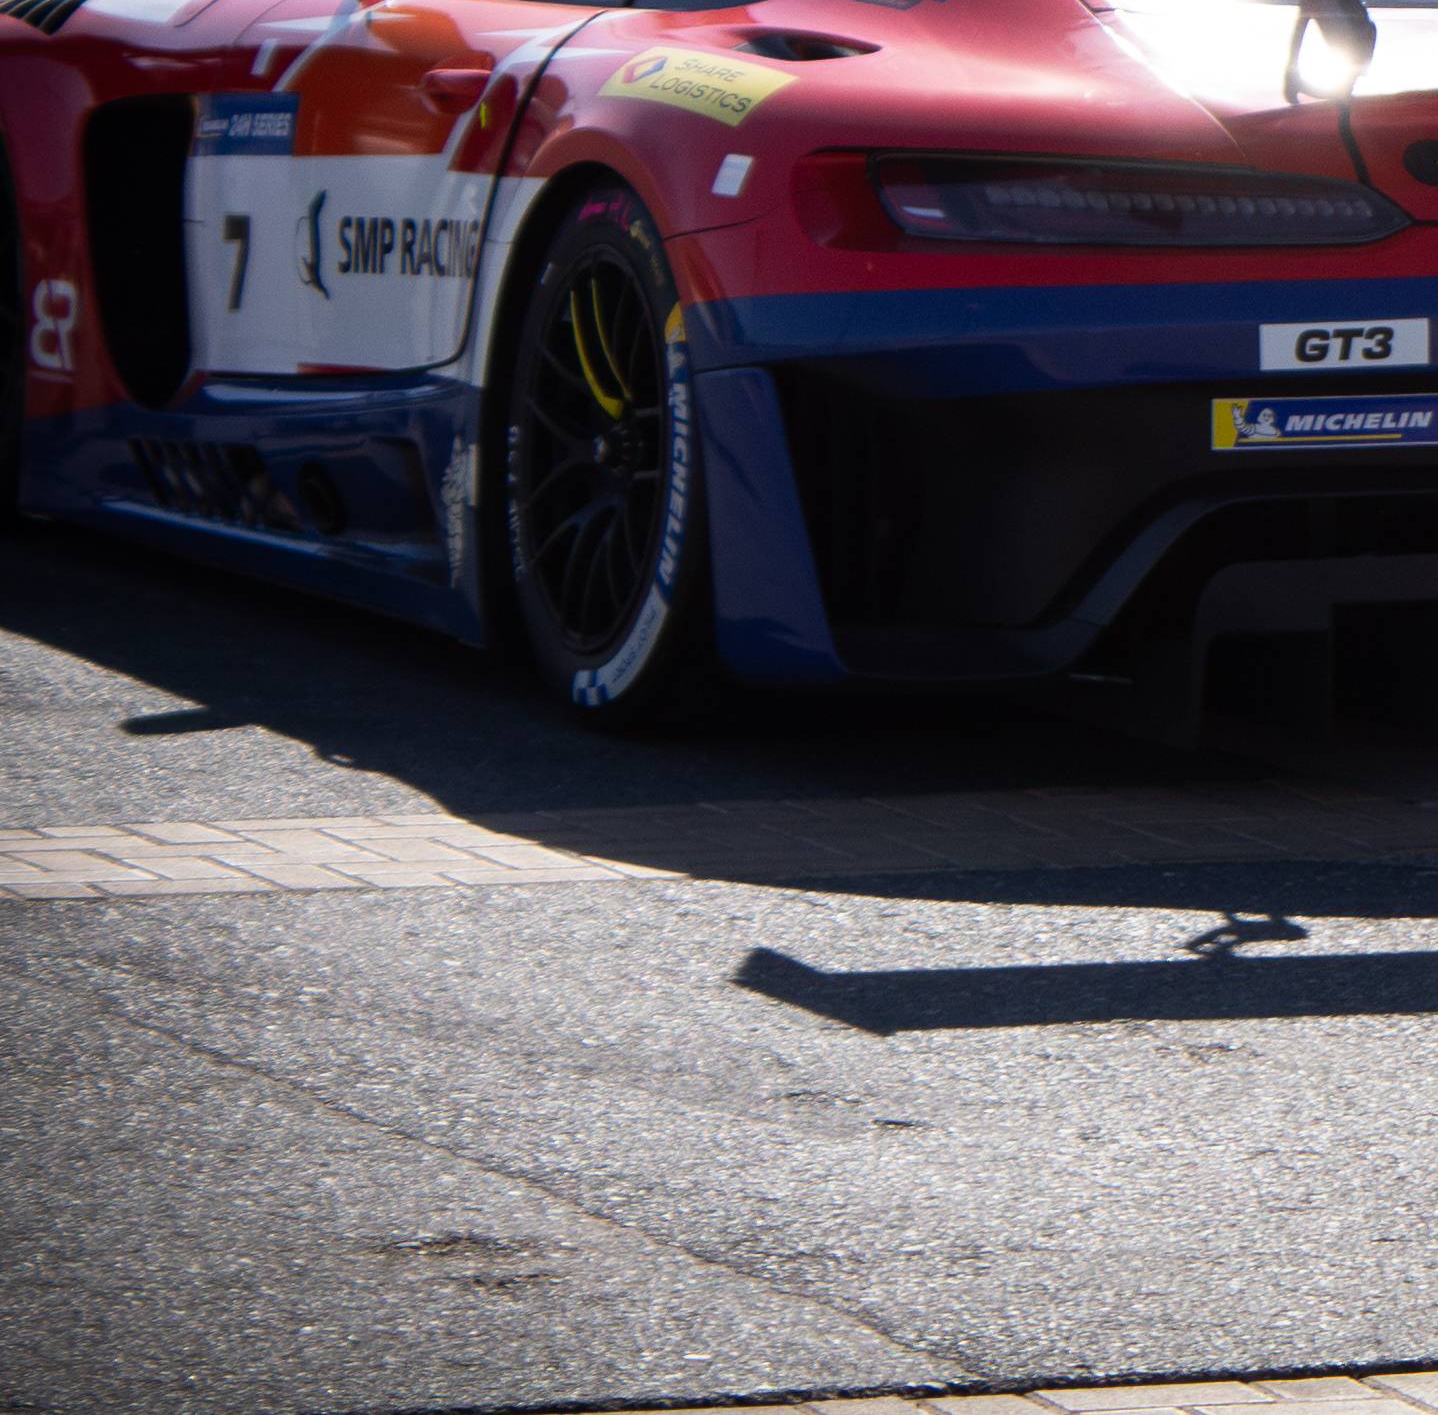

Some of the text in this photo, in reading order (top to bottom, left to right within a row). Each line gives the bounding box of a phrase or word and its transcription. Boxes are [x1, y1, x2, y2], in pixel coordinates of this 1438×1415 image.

[673, 57, 746, 84] SHARE
[650, 73, 752, 114] LOGISTICS
[223, 213, 251, 314] 7
[337, 215, 480, 278] SMP RACING
[1295, 325, 1395, 363] GT3
[1285, 410, 1434, 433] MICHELIN
[657, 382, 690, 586] MICHELIN
